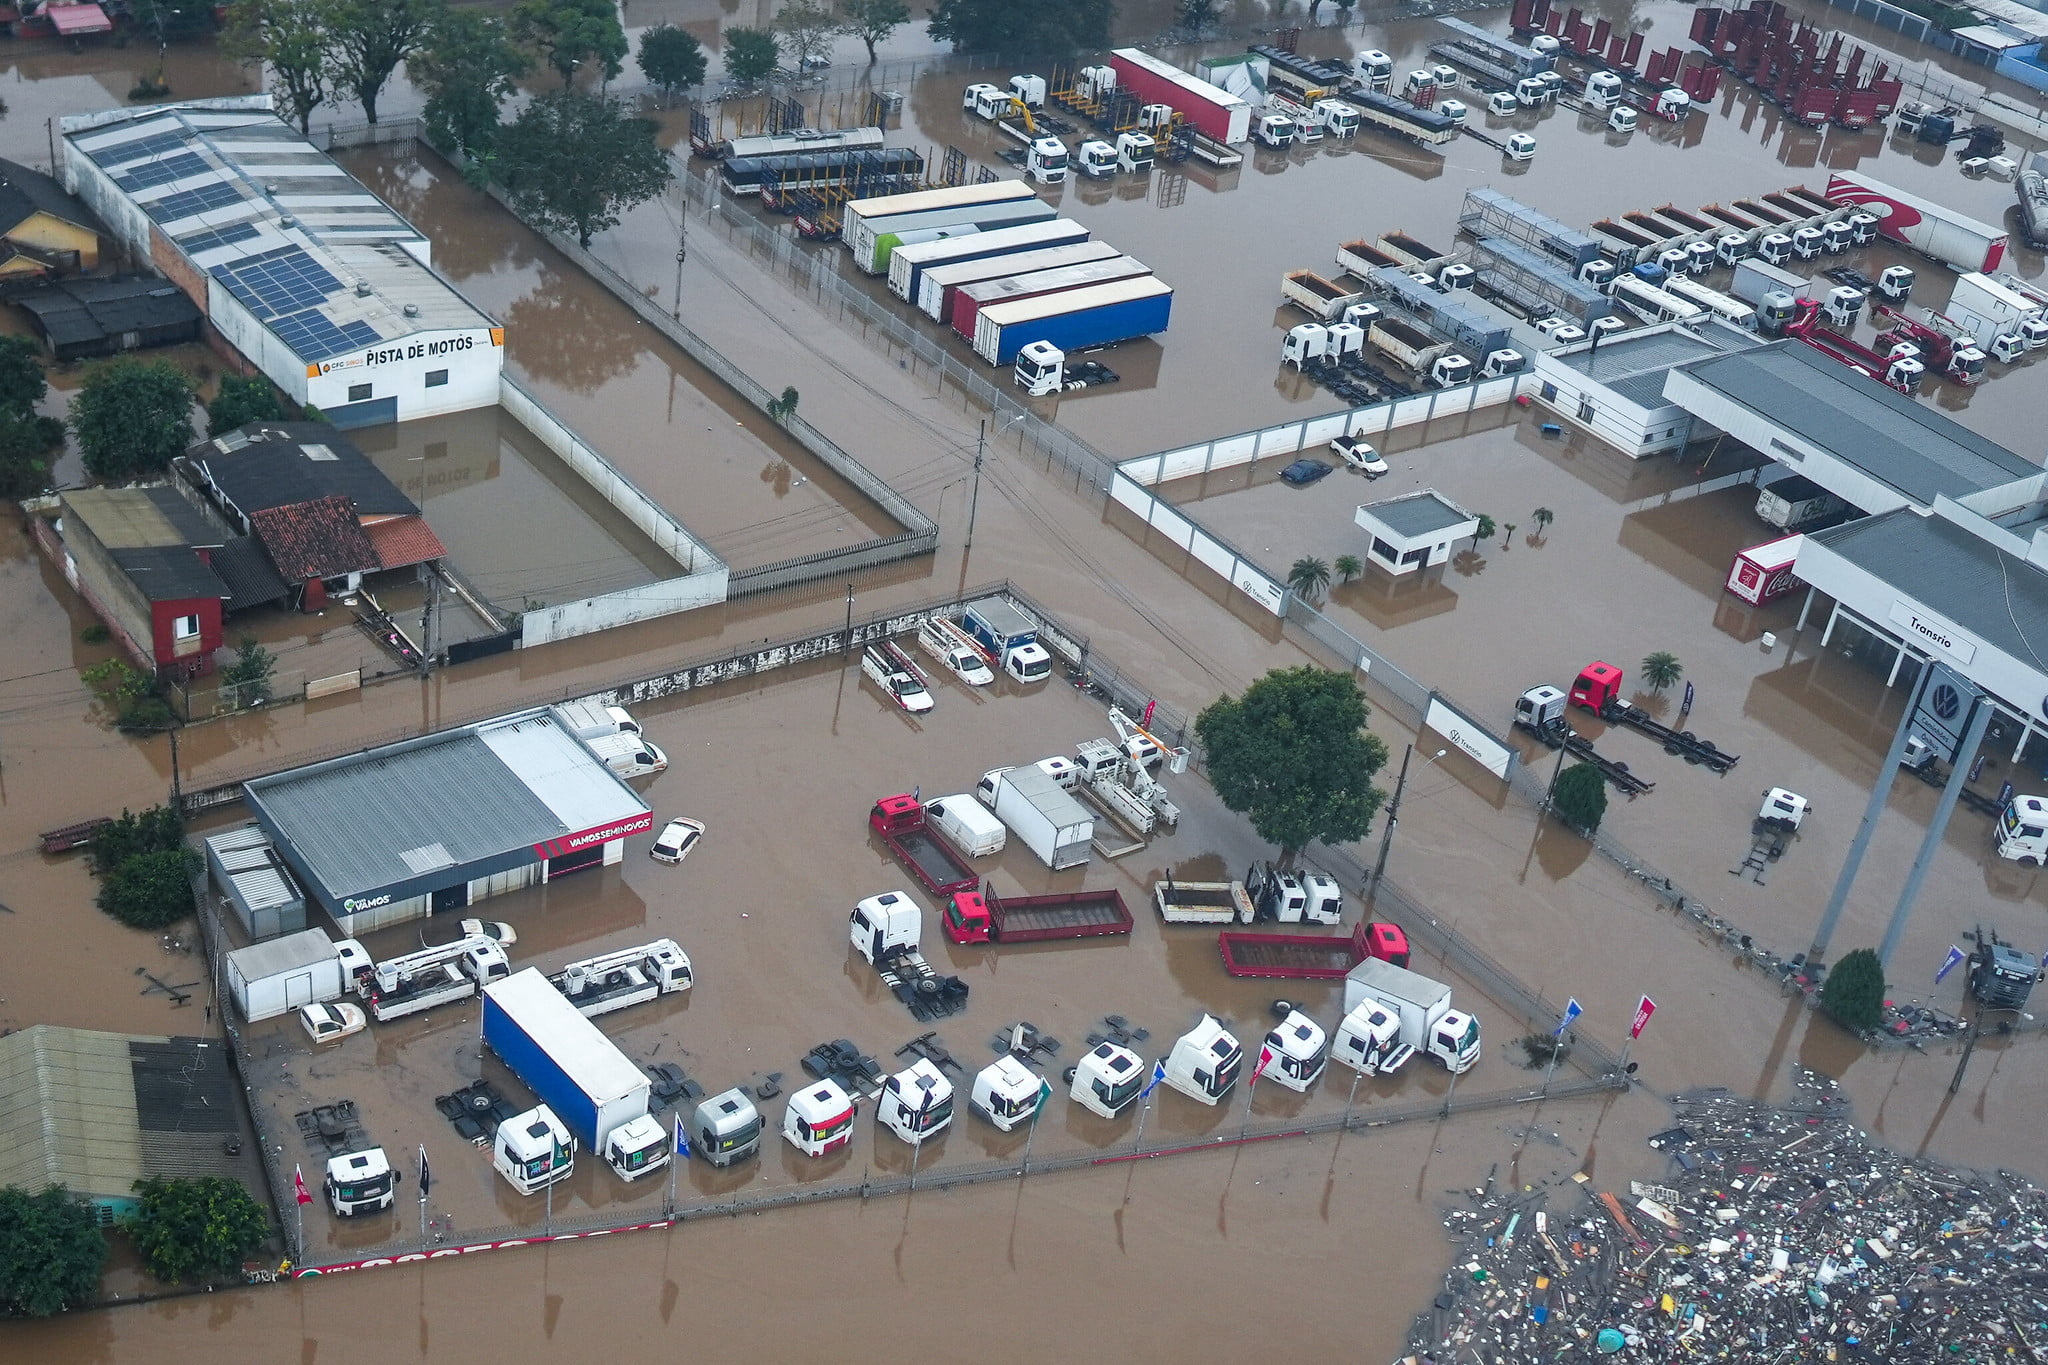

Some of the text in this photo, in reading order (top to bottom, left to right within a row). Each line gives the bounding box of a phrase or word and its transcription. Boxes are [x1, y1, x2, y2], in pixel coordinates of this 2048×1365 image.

[366, 336, 473, 366] PISTA DE MOTOS
[1911, 616, 1952, 648] Transrio
[355, 895, 391, 911] VAMOS
